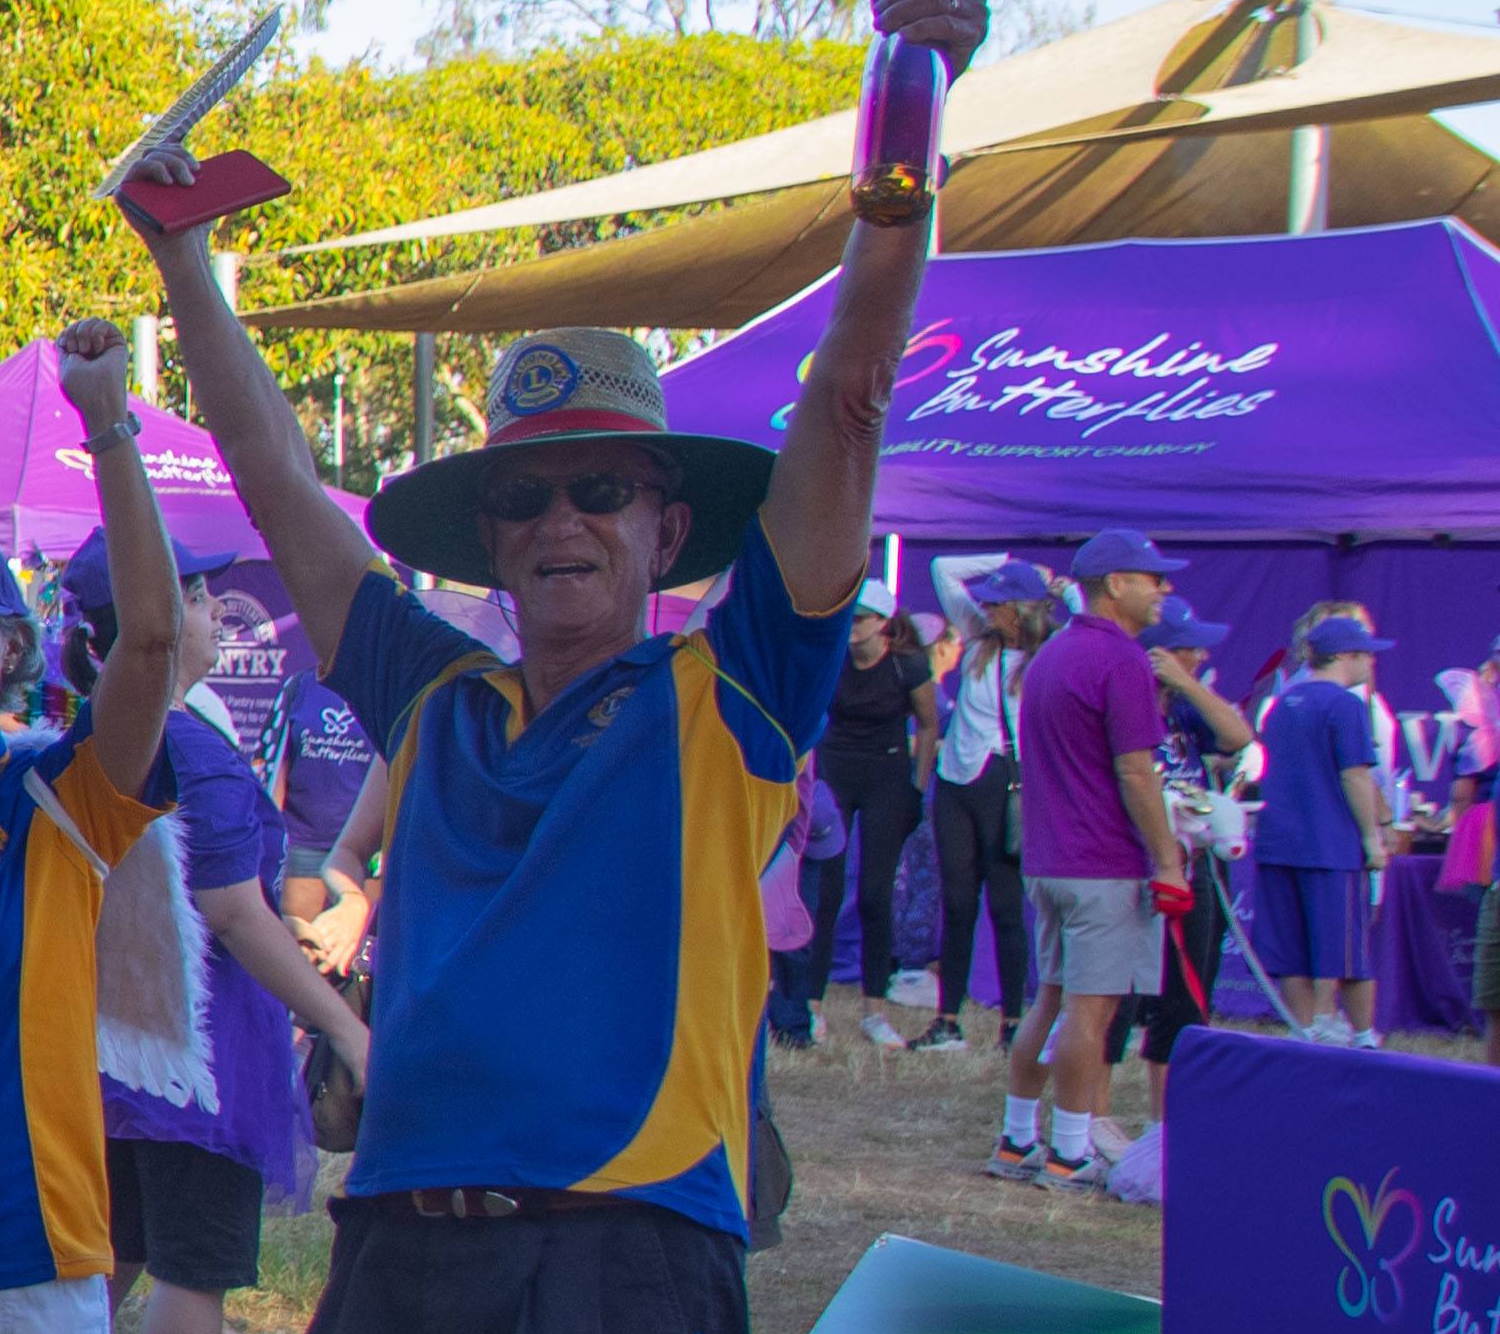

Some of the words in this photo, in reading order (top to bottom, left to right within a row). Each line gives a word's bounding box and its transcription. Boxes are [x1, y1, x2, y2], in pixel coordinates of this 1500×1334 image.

[946, 327, 1280, 378] Sunshine
[905, 375, 1277, 439] Butterflies
[208, 649, 287, 676] NTRY
[300, 728, 365, 749] Sunshine
[301, 742, 371, 766] Butterflies
